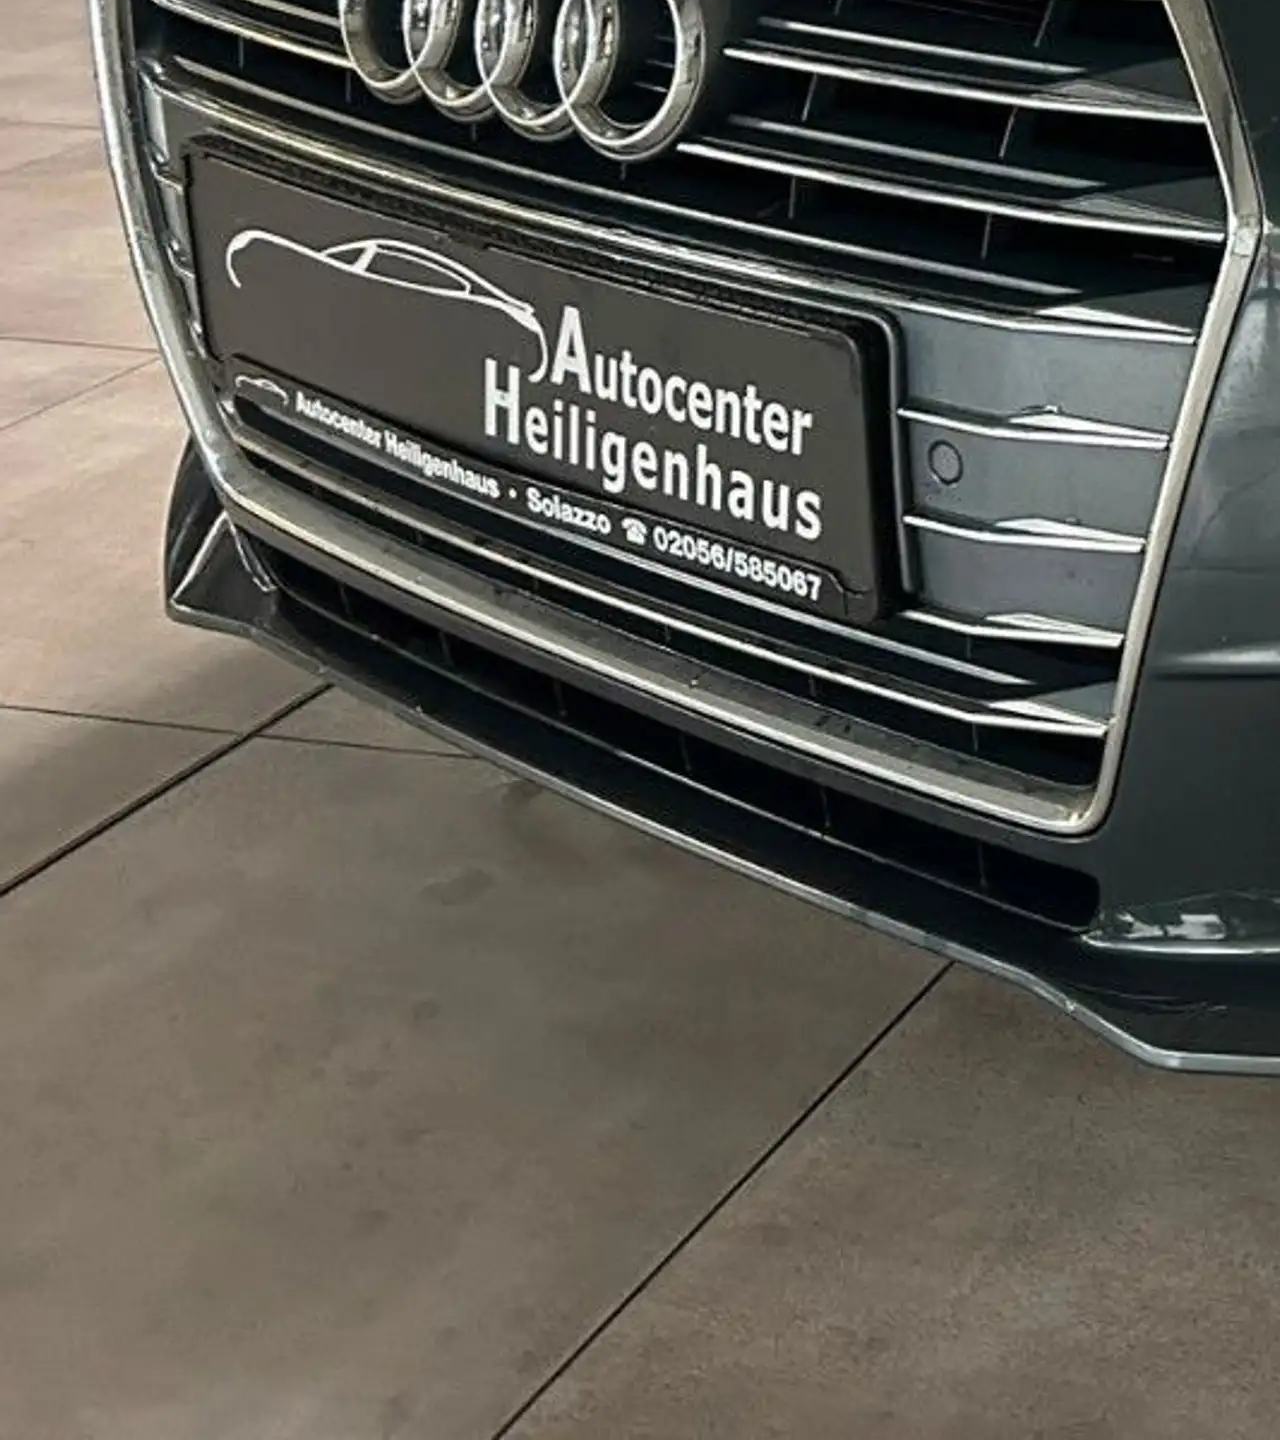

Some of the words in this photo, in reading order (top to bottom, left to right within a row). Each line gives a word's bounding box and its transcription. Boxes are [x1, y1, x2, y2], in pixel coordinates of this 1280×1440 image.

[484, 358, 823, 541] Heiligenhaus
[550, 305, 812, 456] Autocenter
[295, 390, 383, 448] Autocenter
[384, 428, 501, 498] Heiligenhaus
[525, 486, 612, 535] Solazzo
[652, 525, 822, 602] 02056/585067
